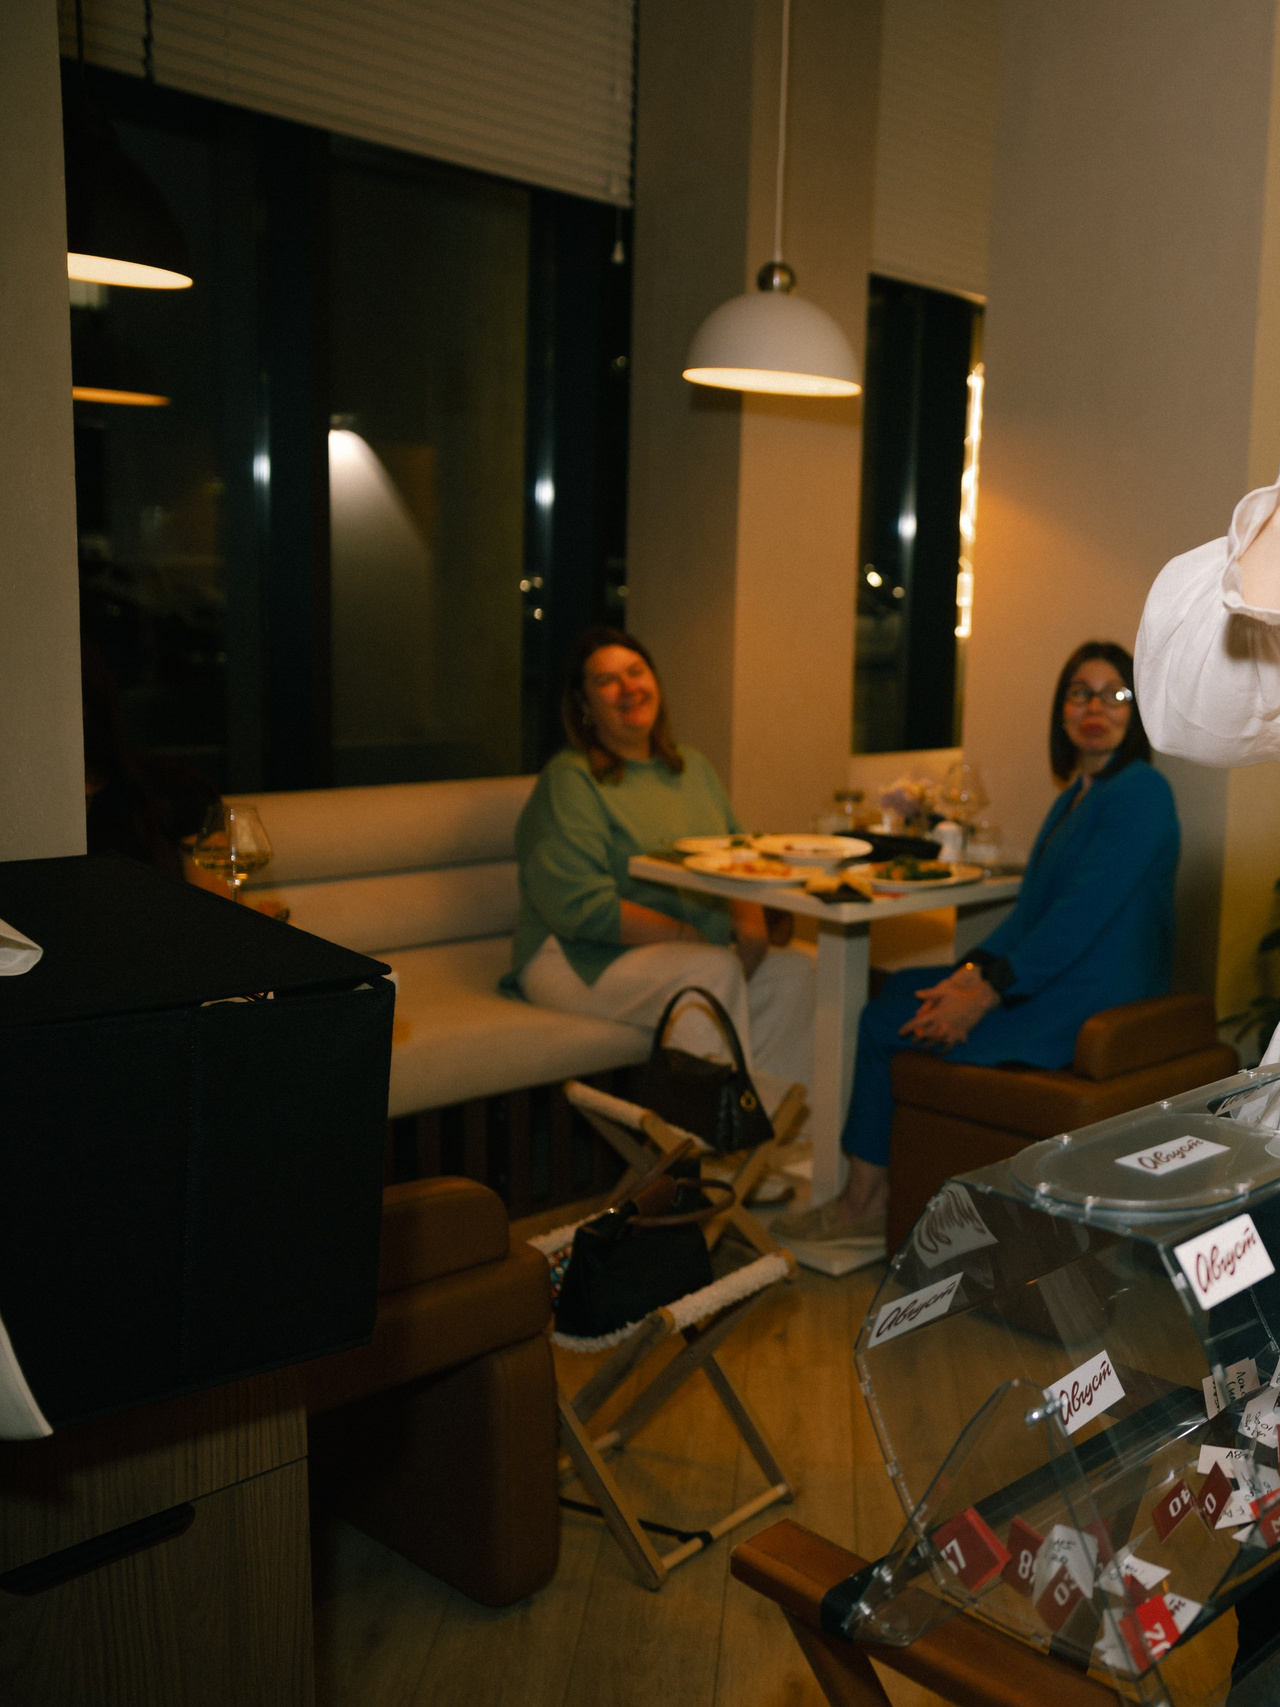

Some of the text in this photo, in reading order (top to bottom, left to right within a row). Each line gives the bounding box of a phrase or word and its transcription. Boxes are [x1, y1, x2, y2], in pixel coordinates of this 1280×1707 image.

[1137, 1138, 1204, 1170] Август
[1195, 1226, 1256, 1293] Август
[875, 1279, 957, 1339] Август
[1059, 1359, 1112, 1426] Август
